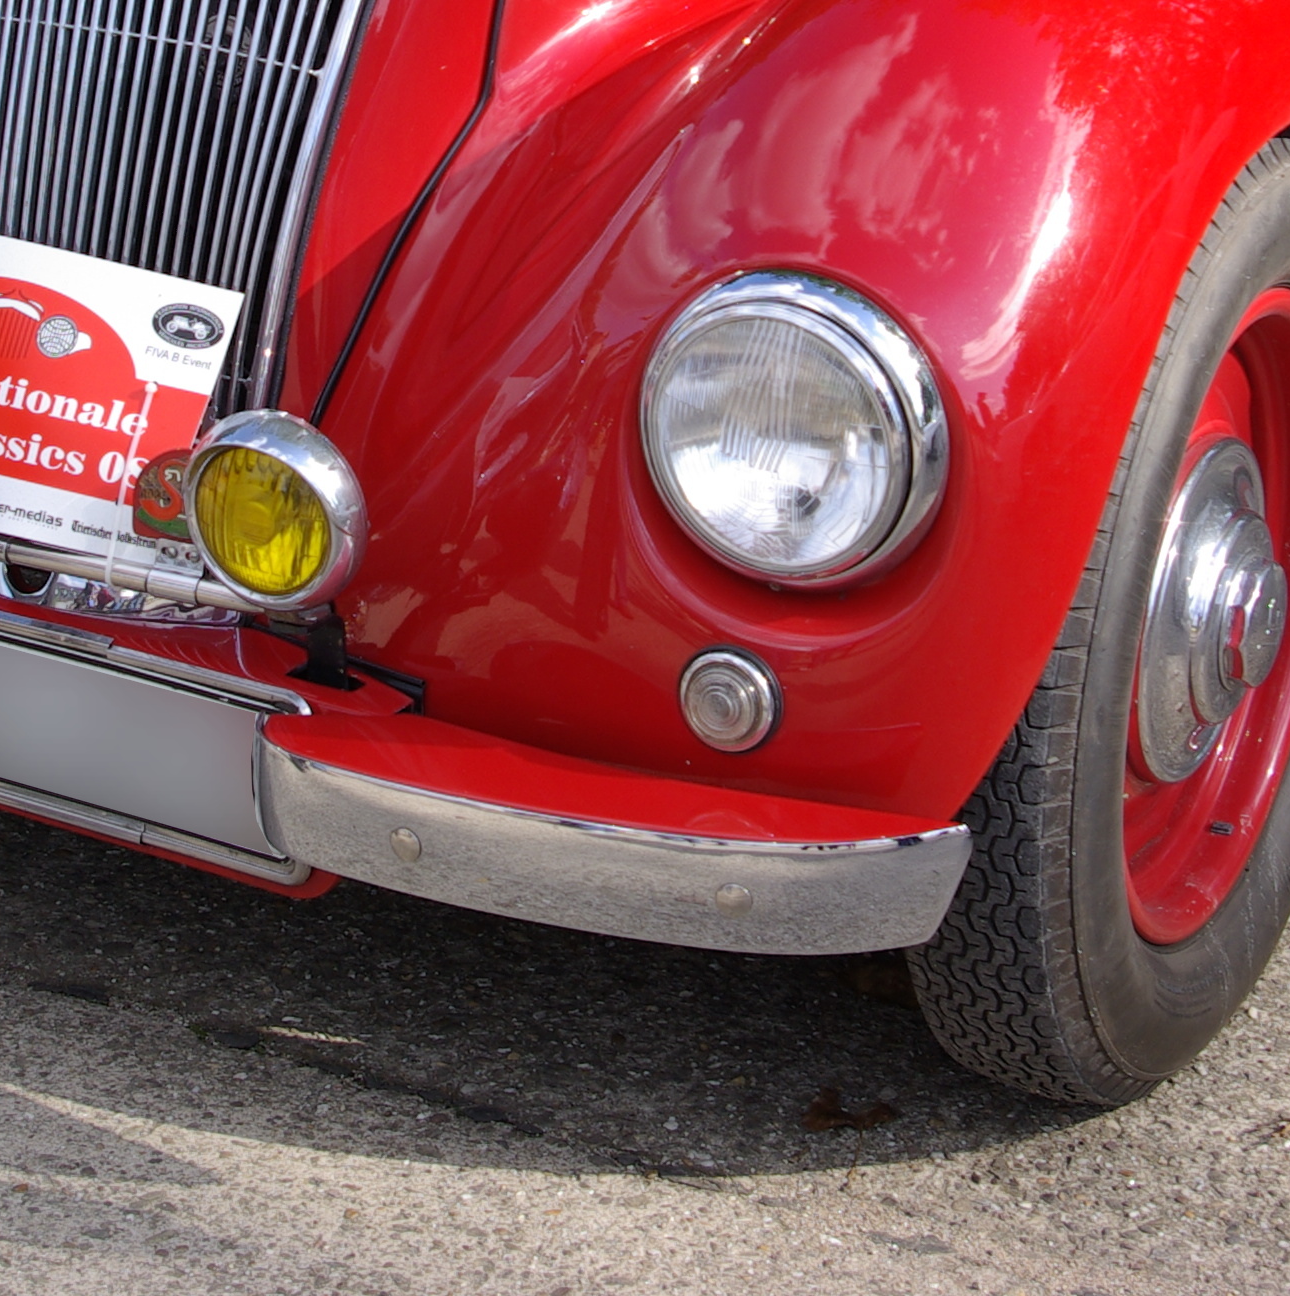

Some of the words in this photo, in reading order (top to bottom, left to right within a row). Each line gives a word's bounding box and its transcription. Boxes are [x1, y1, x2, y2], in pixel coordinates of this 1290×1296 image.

[145, 345, 169, 359] FIVA
[171, 352, 180, 363] B
[183, 355, 211, 369] Event
